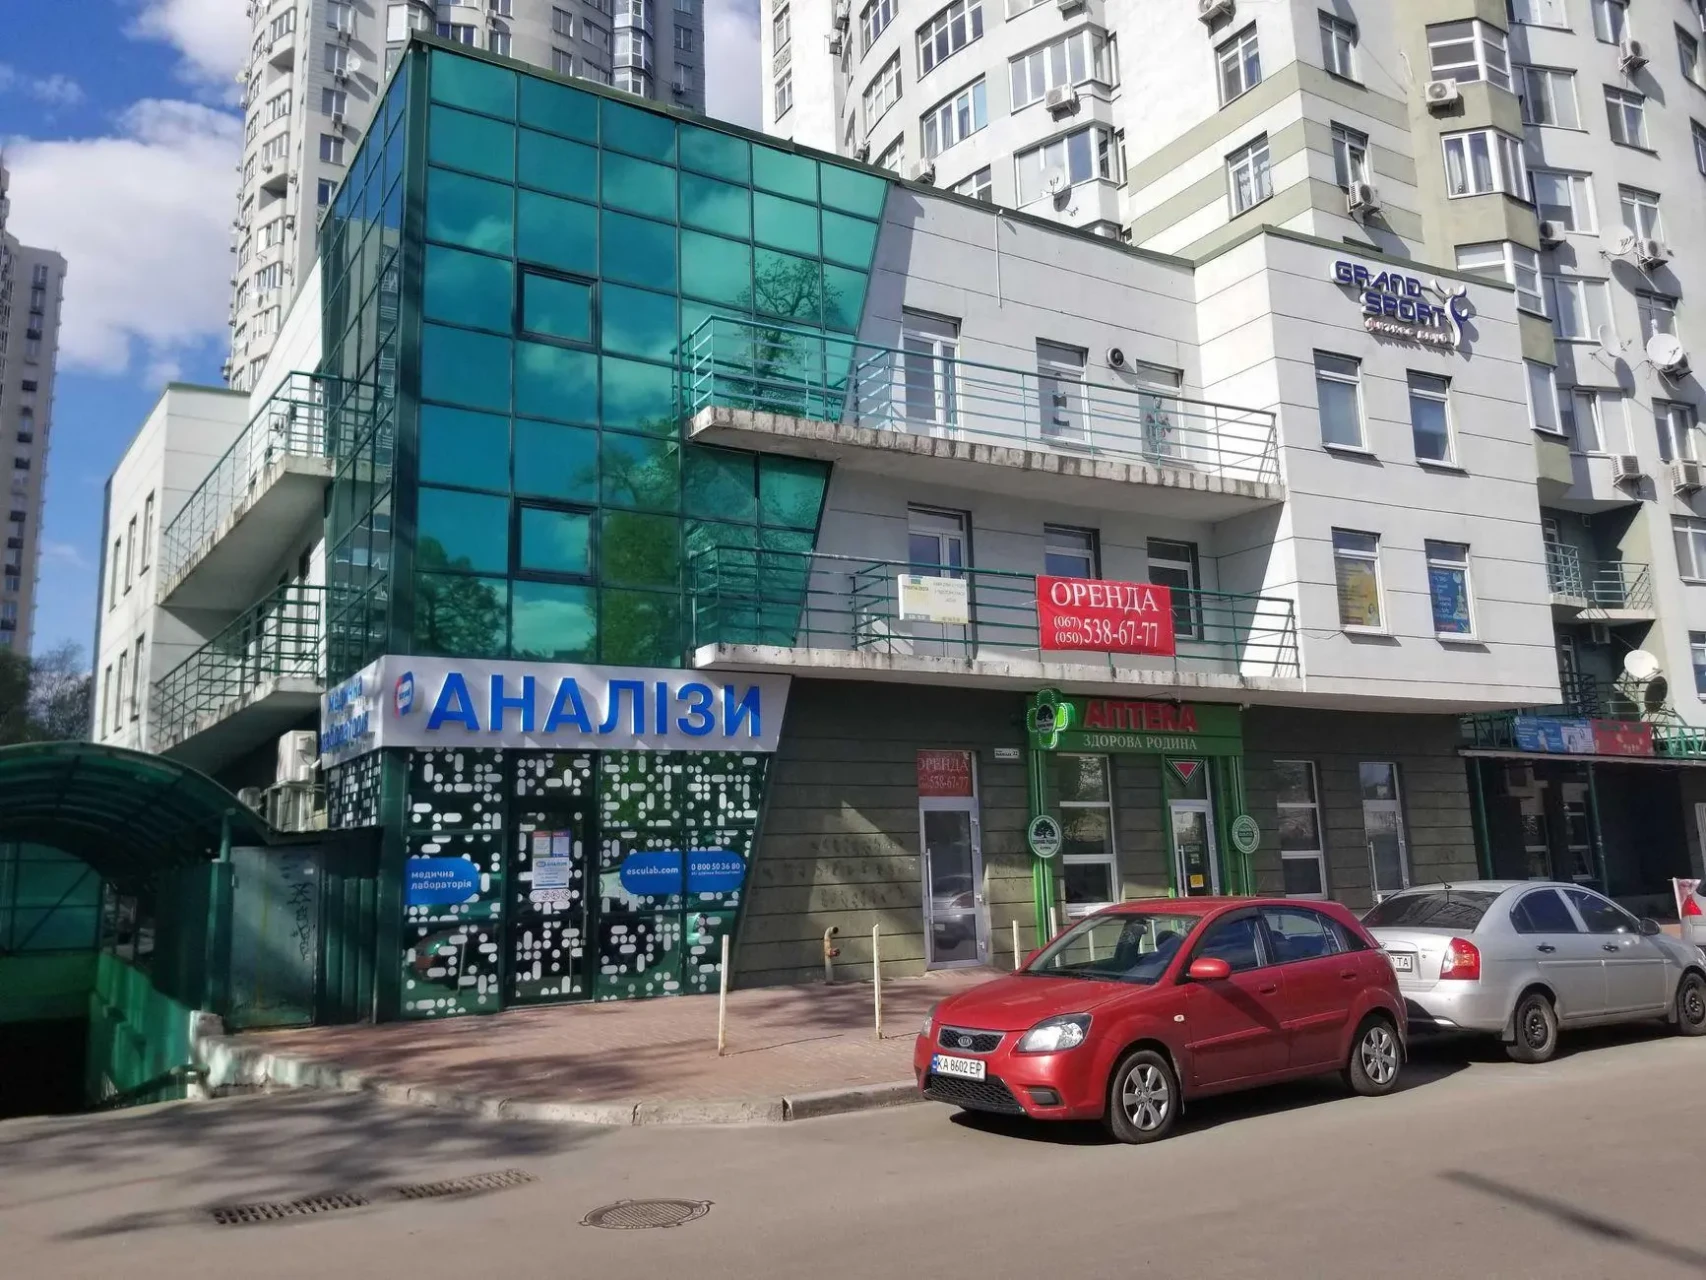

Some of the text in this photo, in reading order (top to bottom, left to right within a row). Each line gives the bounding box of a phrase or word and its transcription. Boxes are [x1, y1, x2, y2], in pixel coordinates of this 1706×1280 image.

[1330, 260, 1421, 297] GRAND
[1359, 292, 1446, 328] SPORT
[1051, 581, 1159, 615] ОРЕНДА
[1054, 616, 1159, 648] (067) 538-67-77
[1055, 631, 1083, 646] (050)
[426, 672, 762, 737] АНАЛІЗИ
[1084, 700, 1199, 732] АПТЕКА
[1083, 734, 1198, 751] ЗДОРОВА РОДИНА
[411, 870, 454, 879] медична
[626, 865, 679, 876] esculab.com
[691, 862, 740, 871] 0 800 50 36 80
[411, 879, 472, 891] лабораторія
[937, 1056, 983, 1075] KA 8602 EP
